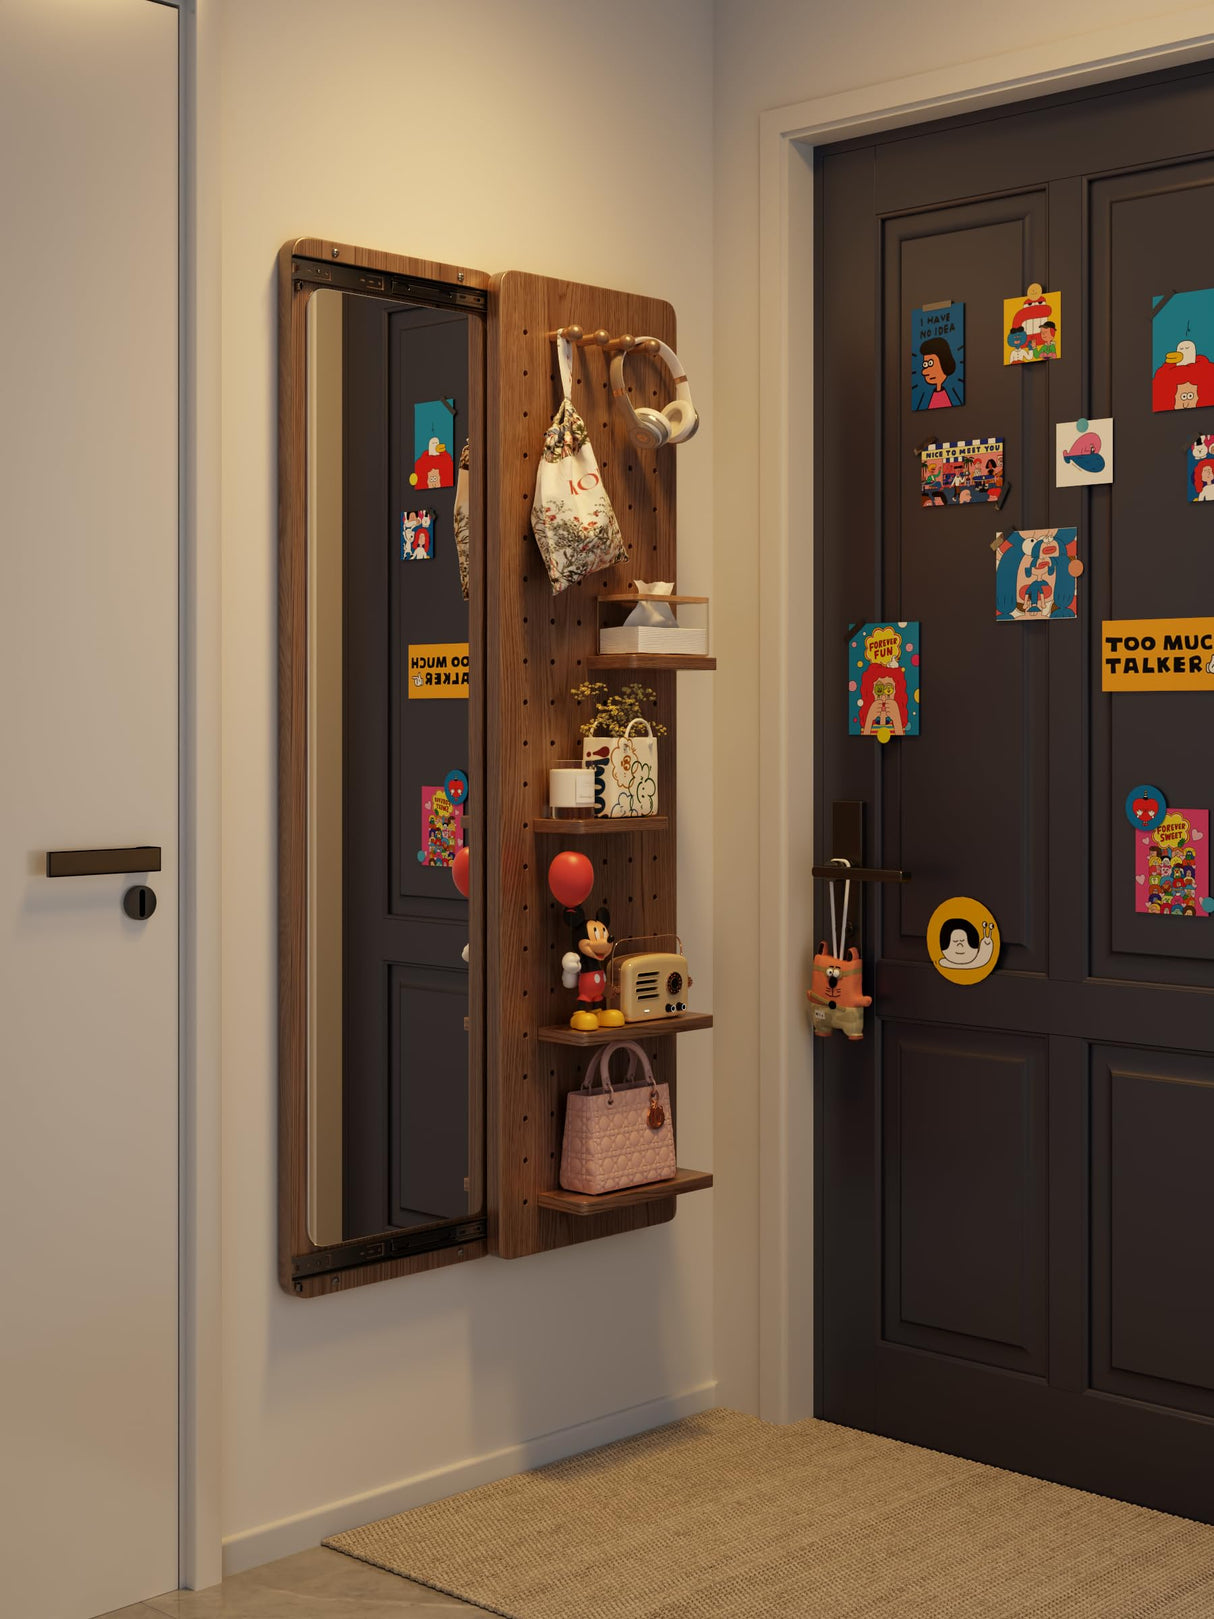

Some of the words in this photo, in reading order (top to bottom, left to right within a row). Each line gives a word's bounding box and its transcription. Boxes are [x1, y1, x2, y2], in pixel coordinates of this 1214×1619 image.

[927, 312, 951, 324] HAVE
[920, 328, 932, 339] NO
[934, 322, 956, 336] IDEA
[925, 450, 943, 459] NICE
[946, 449, 957, 457] TO
[959, 446, 981, 455] MEET
[984, 444, 1001, 452] YOU
[869, 637, 898, 652] FOREVER
[1105, 636, 1156, 652] TOO
[874, 646, 893, 660] FUN
[1105, 655, 1203, 674] TALKER
[1157, 823, 1186, 834] FOREVER
[1160, 831, 1182, 842] SWEET
